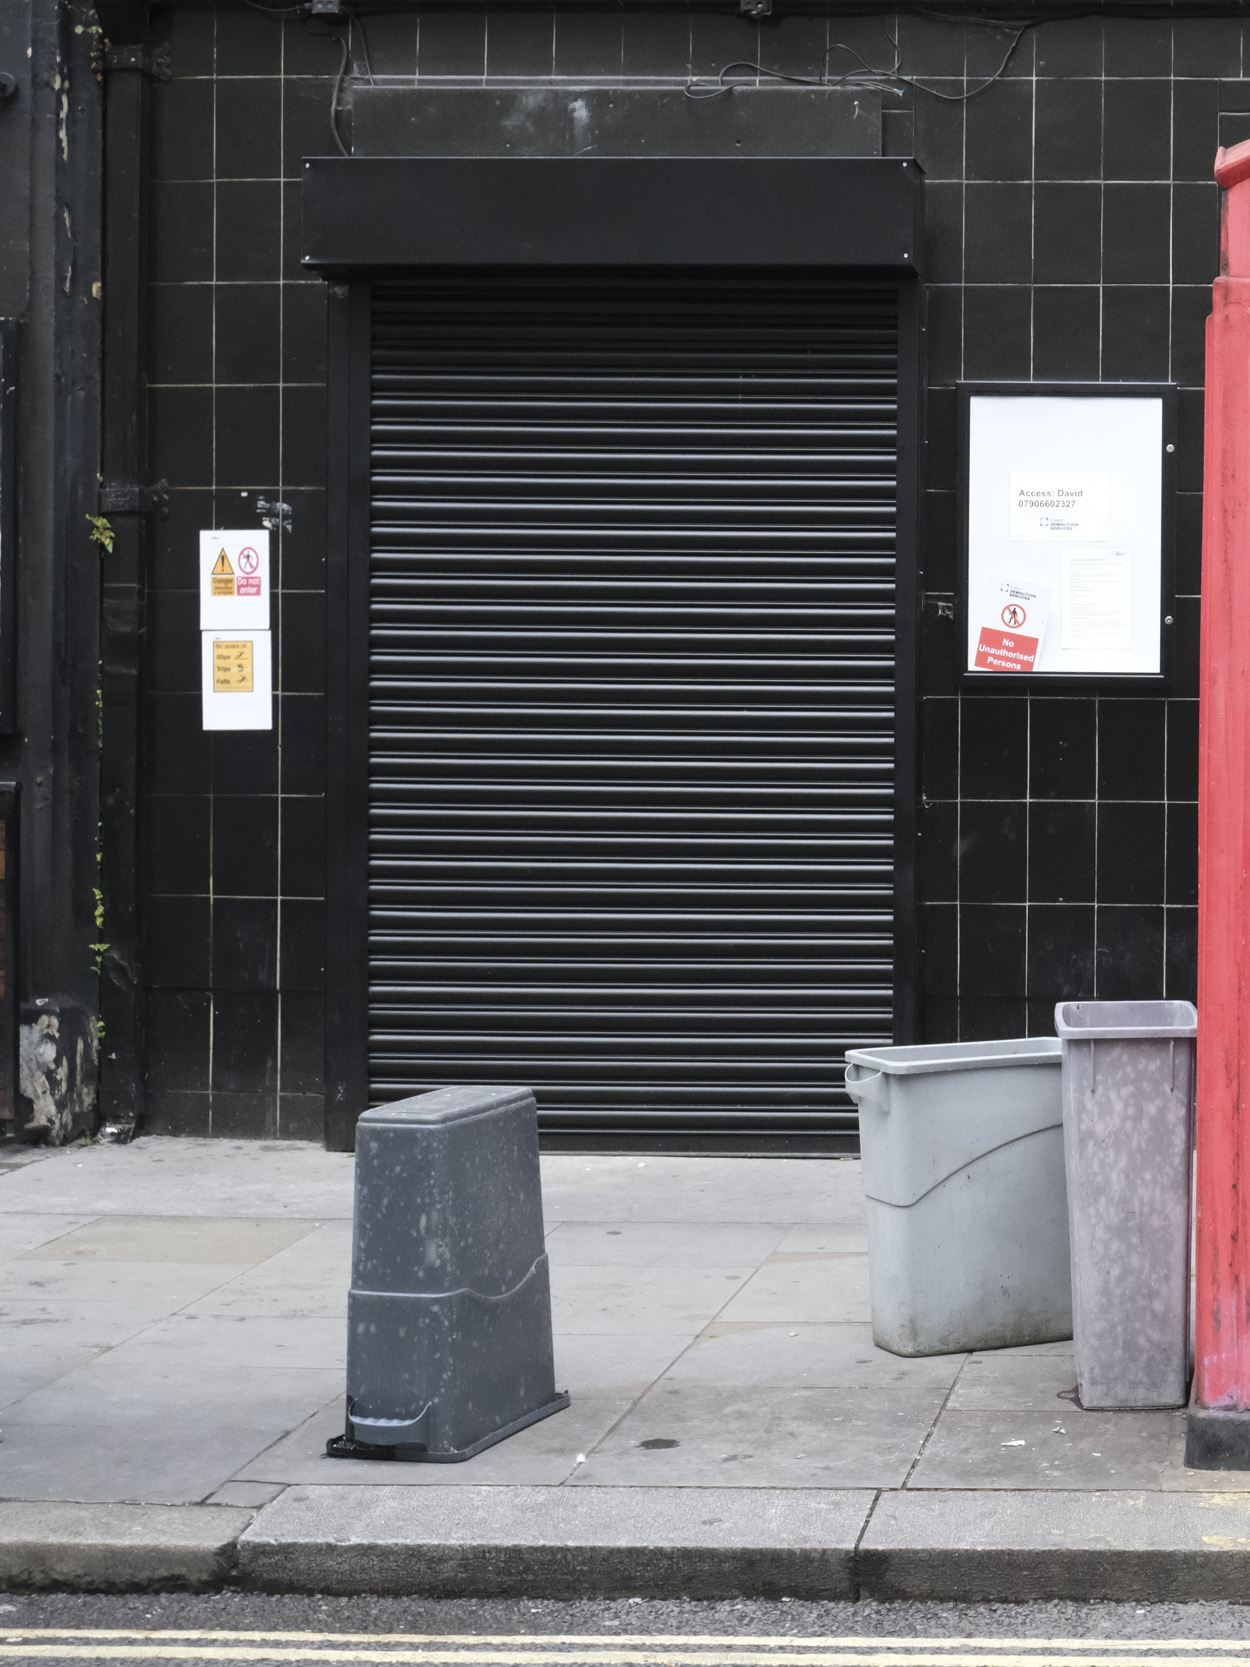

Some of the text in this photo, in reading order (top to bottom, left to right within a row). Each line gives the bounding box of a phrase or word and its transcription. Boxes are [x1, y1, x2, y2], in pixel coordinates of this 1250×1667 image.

[1018, 489, 1083, 498] Access: David
[1018, 499, 1076, 508] 07906602327
[213, 577, 233, 586] Danger
[237, 577, 260, 585] Do not
[1002, 638, 1015, 647] No
[978, 643, 1035, 662] Unauthorised
[987, 656, 1022, 670] Persons
